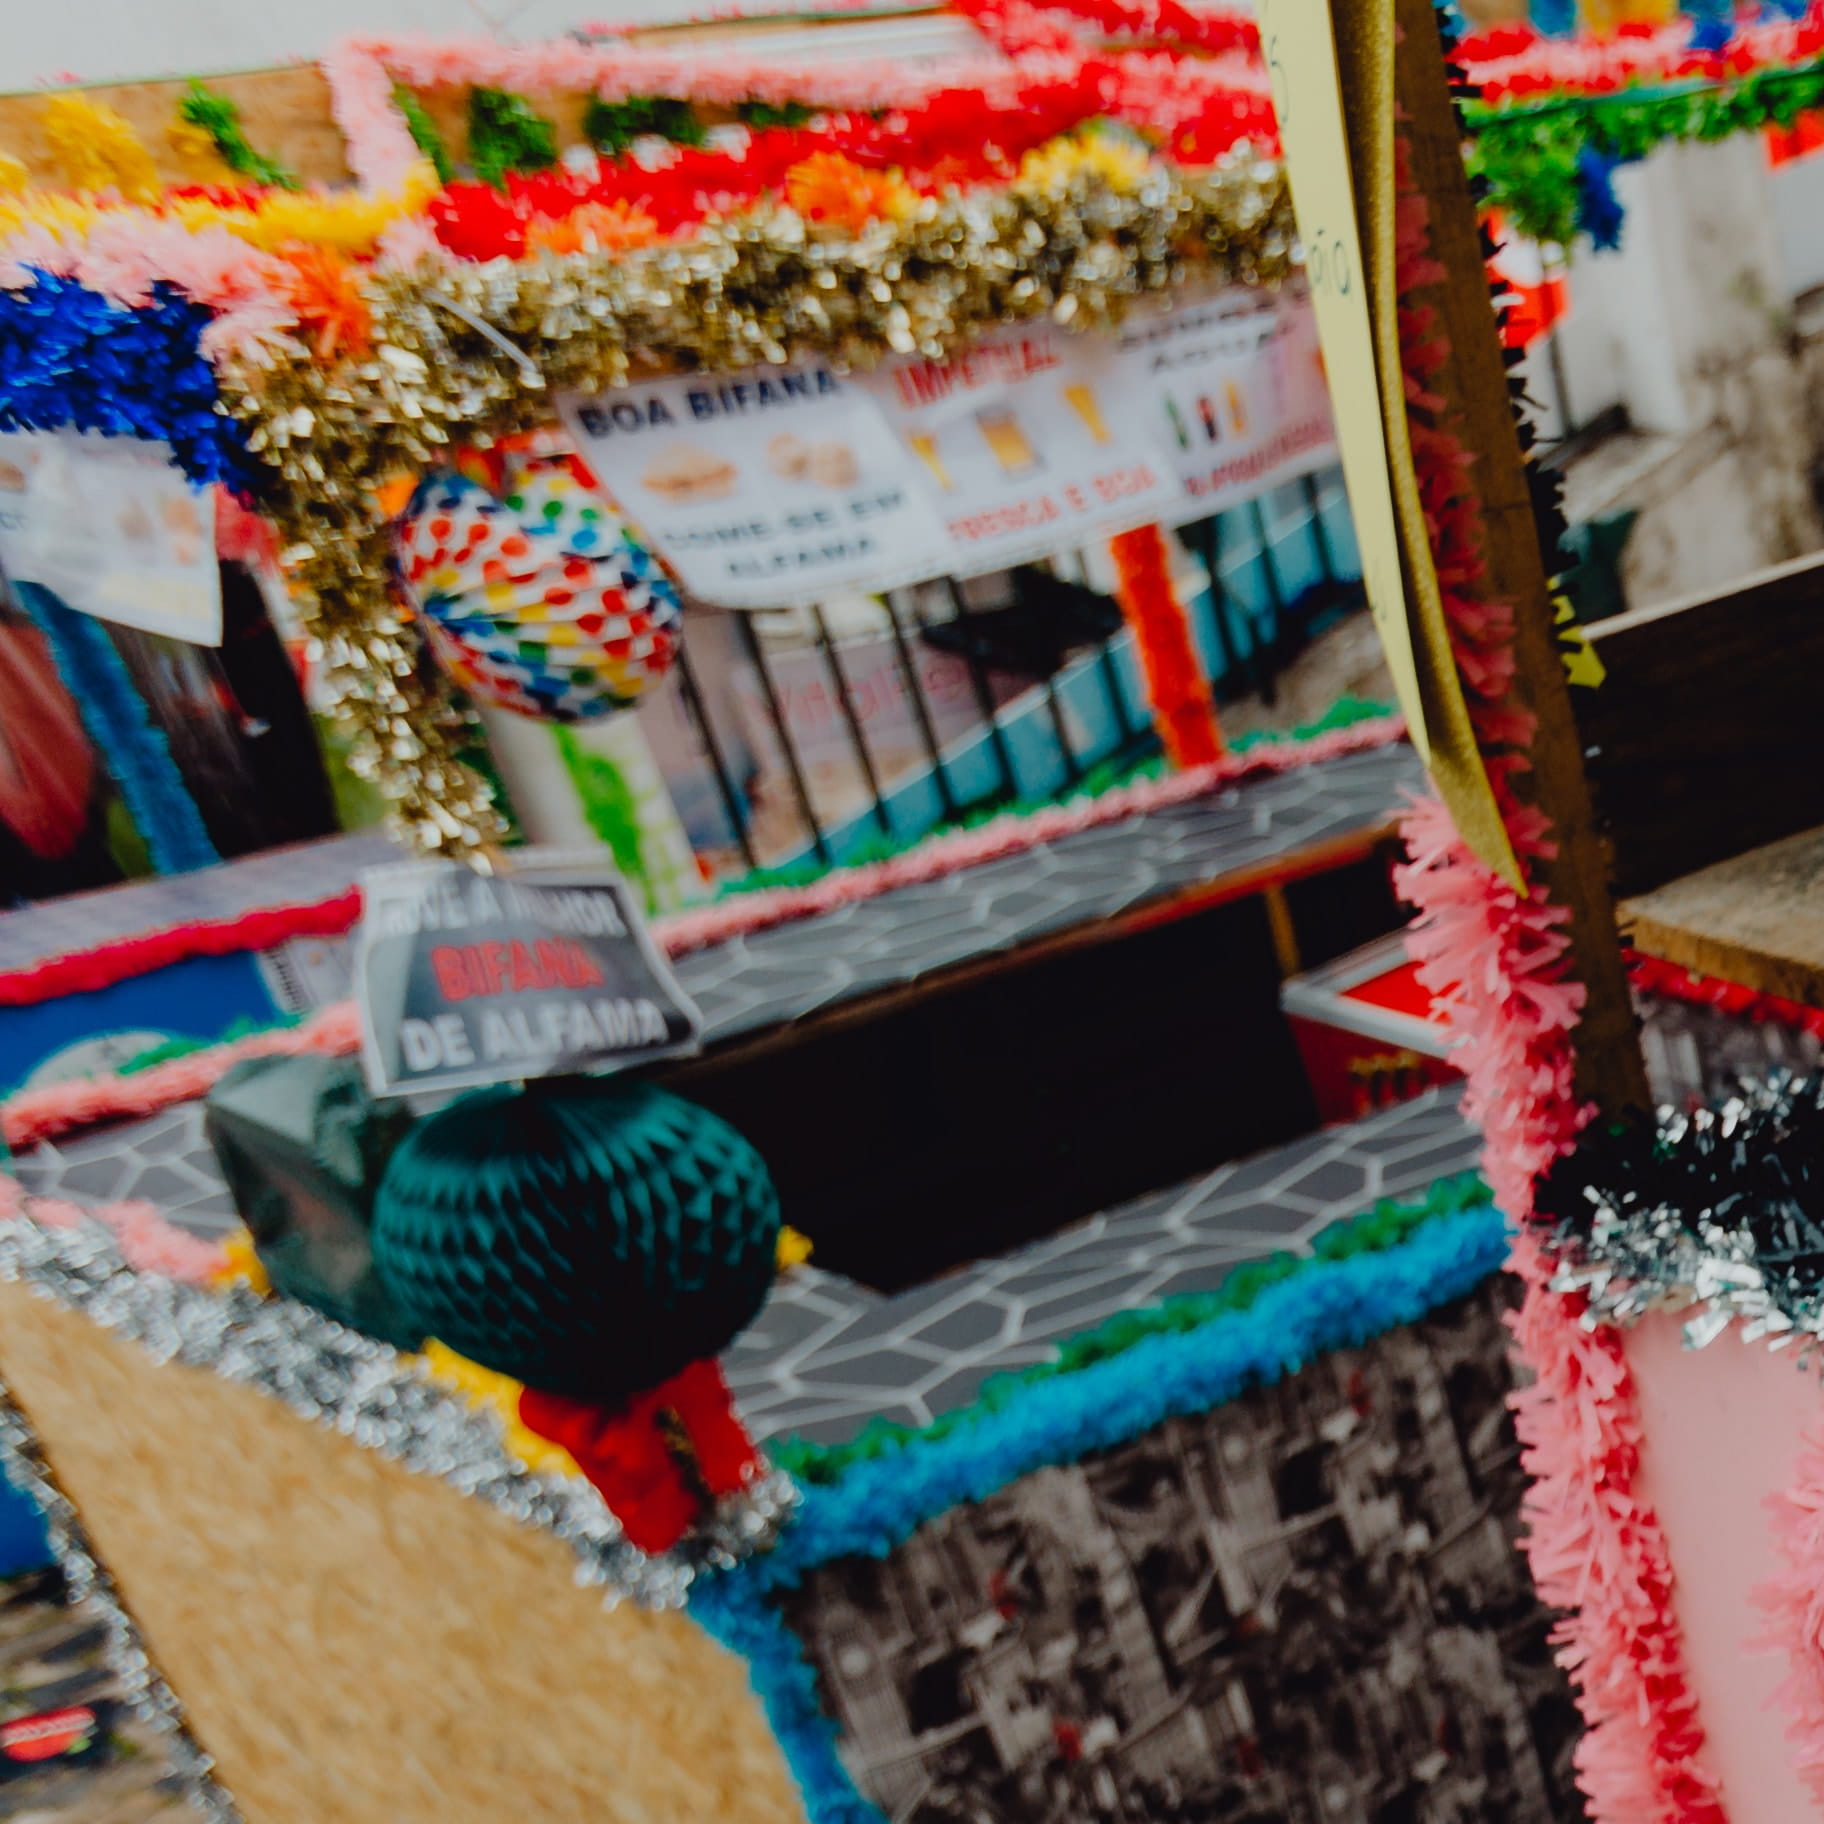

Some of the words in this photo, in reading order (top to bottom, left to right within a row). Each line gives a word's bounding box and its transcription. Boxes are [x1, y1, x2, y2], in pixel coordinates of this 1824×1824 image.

[576, 396, 675, 438] BOA
[686, 366, 840, 421] BIFANA
[431, 935, 606, 1002] BIFANA
[400, 1013, 475, 1073] DE
[481, 997, 670, 1061] ALFAMA
